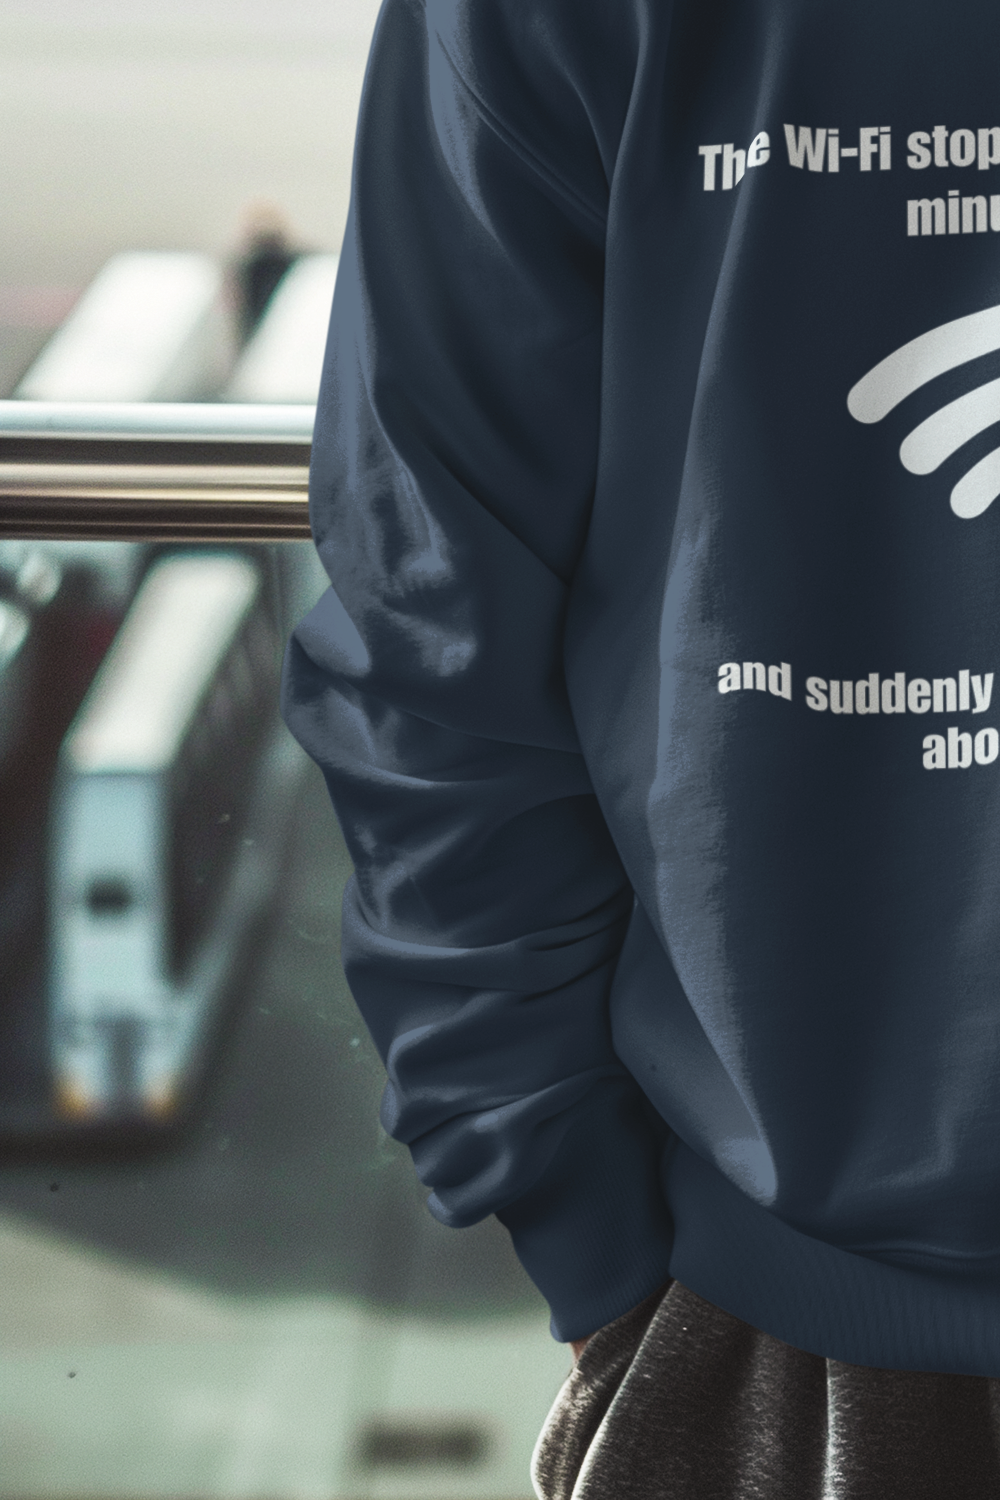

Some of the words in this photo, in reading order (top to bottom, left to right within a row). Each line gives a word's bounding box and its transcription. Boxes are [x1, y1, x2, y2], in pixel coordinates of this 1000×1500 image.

[698, 131, 770, 191] The
[783, 124, 891, 173] Wi-Fi
[717, 661, 792, 700] and
[806, 669, 994, 714] suddenly
